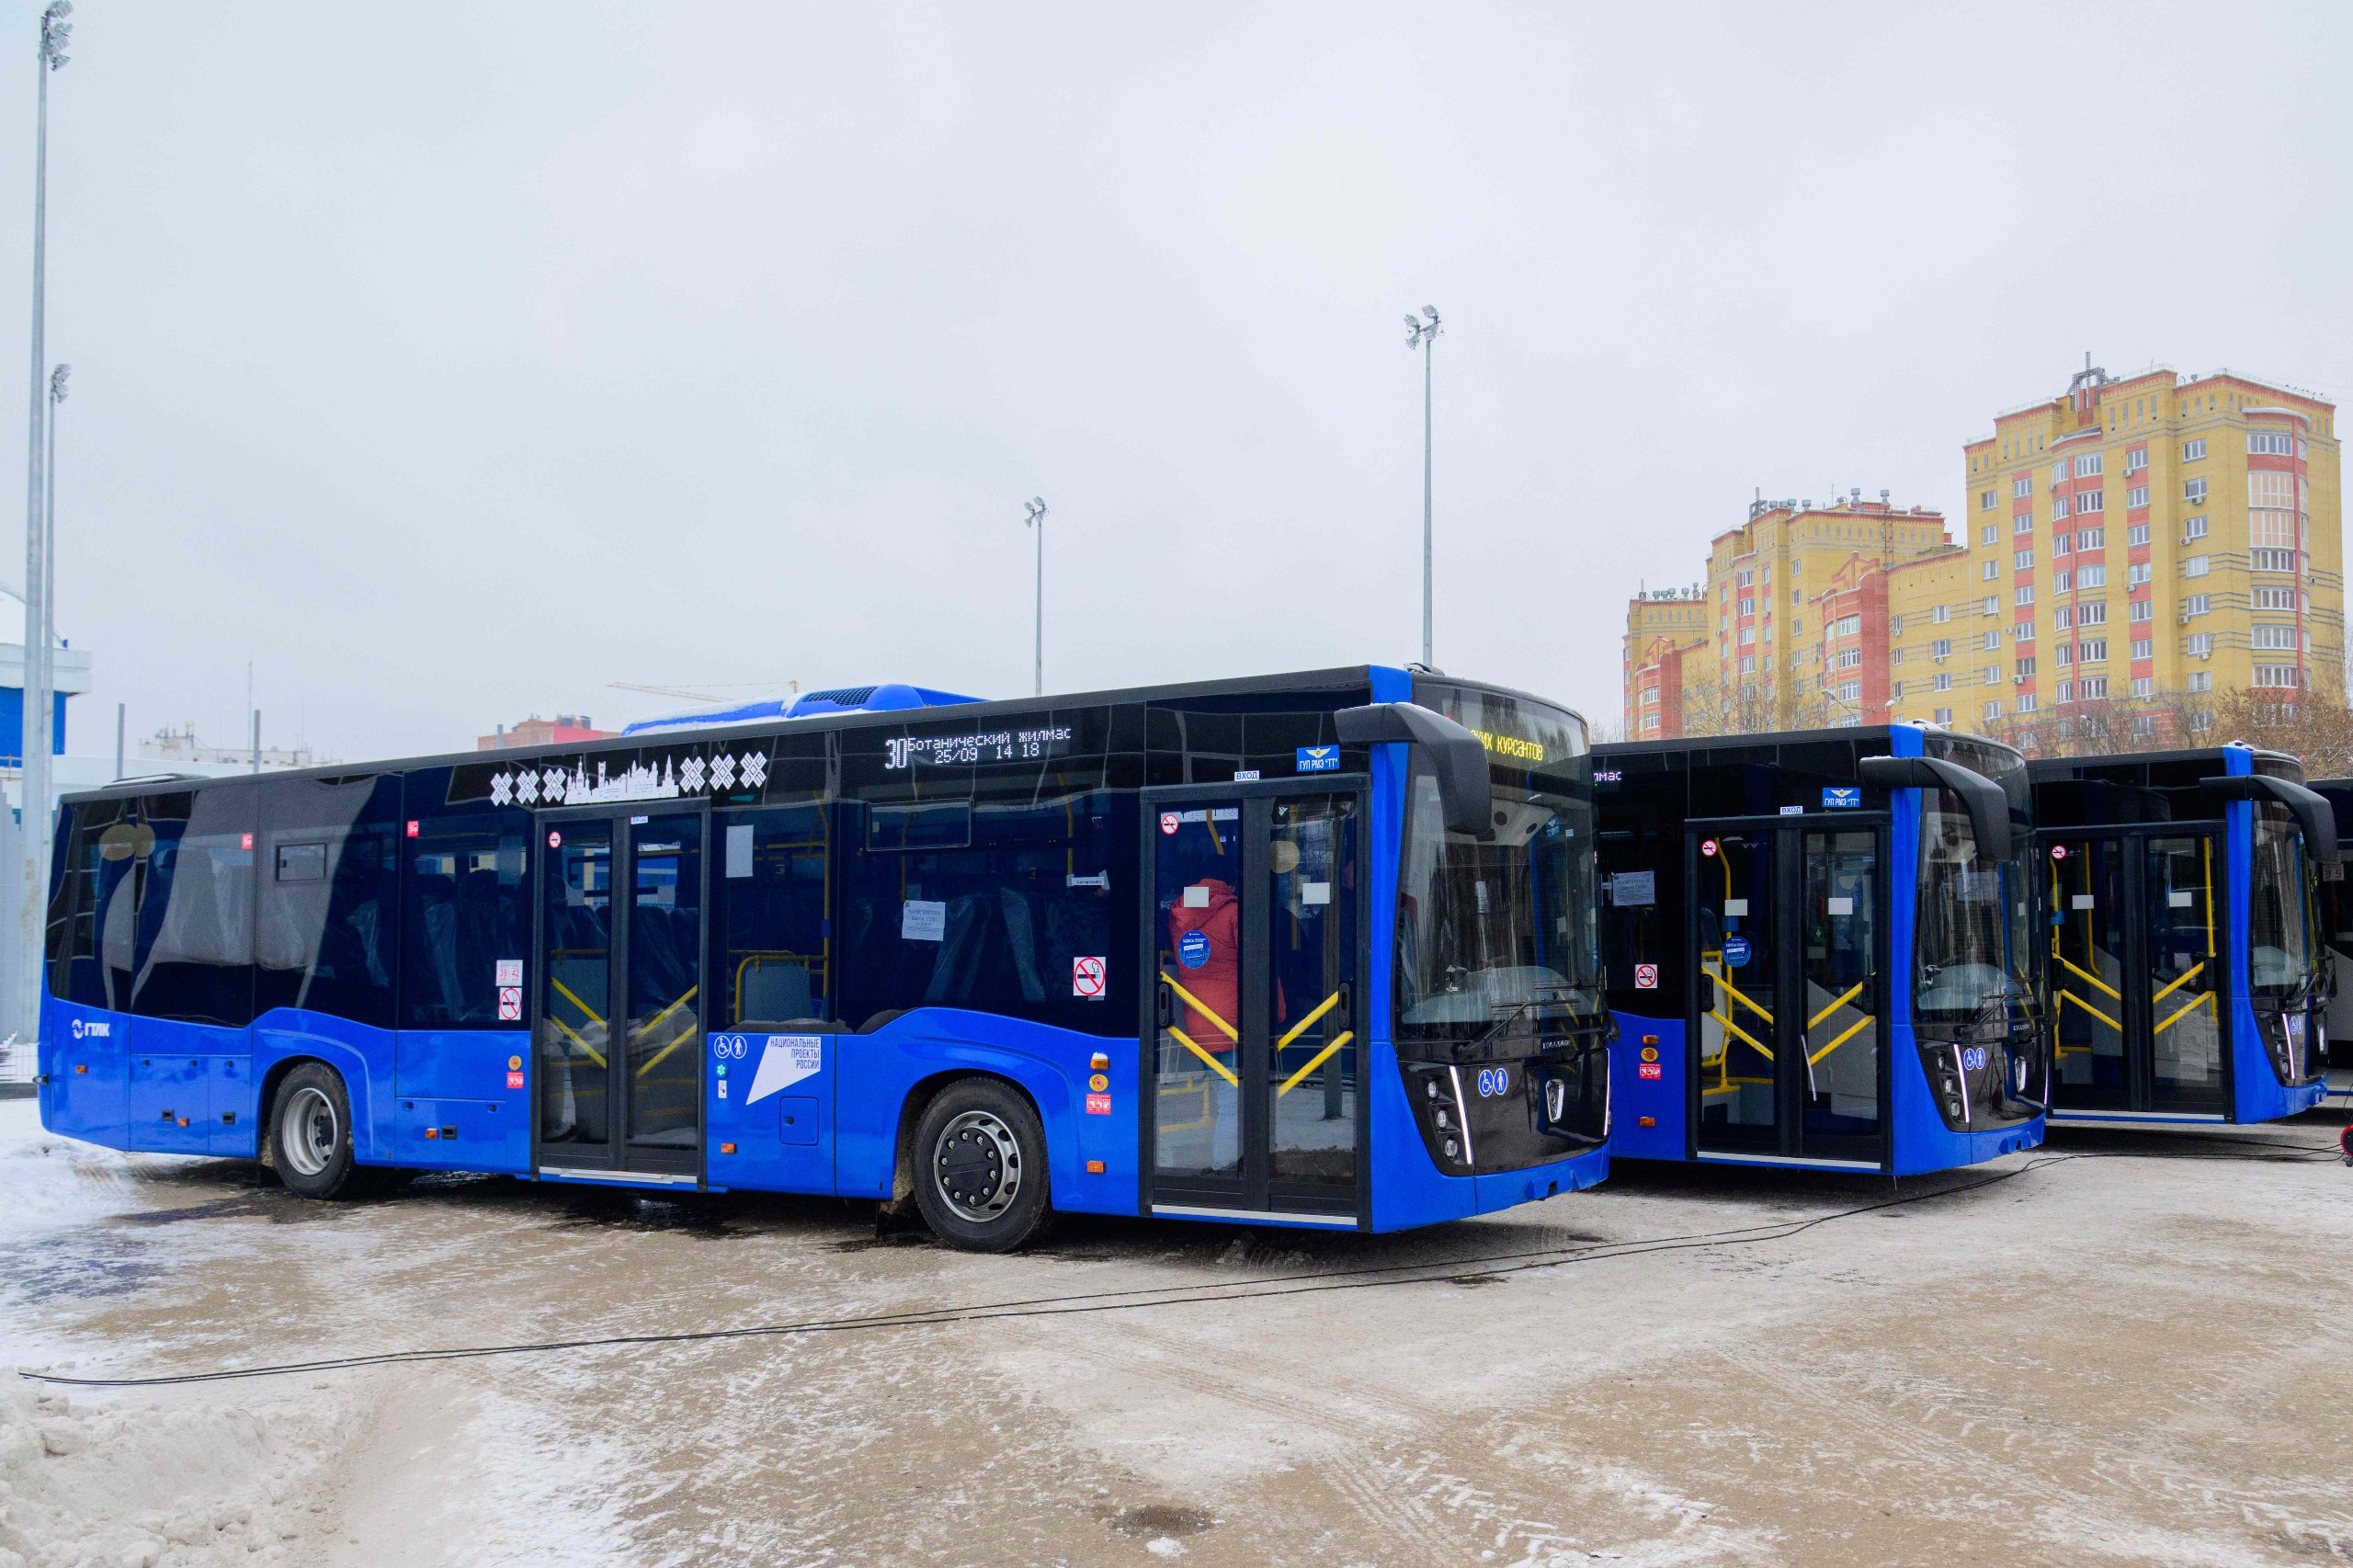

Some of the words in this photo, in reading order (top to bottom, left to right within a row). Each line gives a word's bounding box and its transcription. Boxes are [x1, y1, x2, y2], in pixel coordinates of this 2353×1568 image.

[907, 732, 1010, 751] Ботанический
[1018, 729, 1071, 743] жилмас
[885, 738, 907, 768] 30
[935, 747, 978, 764] 25/09
[996, 744, 1012, 759] 14
[1022, 743, 1040, 757] 18
[1496, 735, 1543, 761] курсантов
[1299, 760, 1311, 770] ГУП
[1312, 759, 1324, 769] РМЭ
[1824, 798, 1835, 806] ГУП
[85, 1022, 110, 1037] ГТЛК
[770, 1038, 820, 1048] НАЦИОНАЛЬНЫЕ
[790, 1049, 820, 1058] ПРОЕКТЫ
[796, 1059, 820, 1069] РОССИИ
